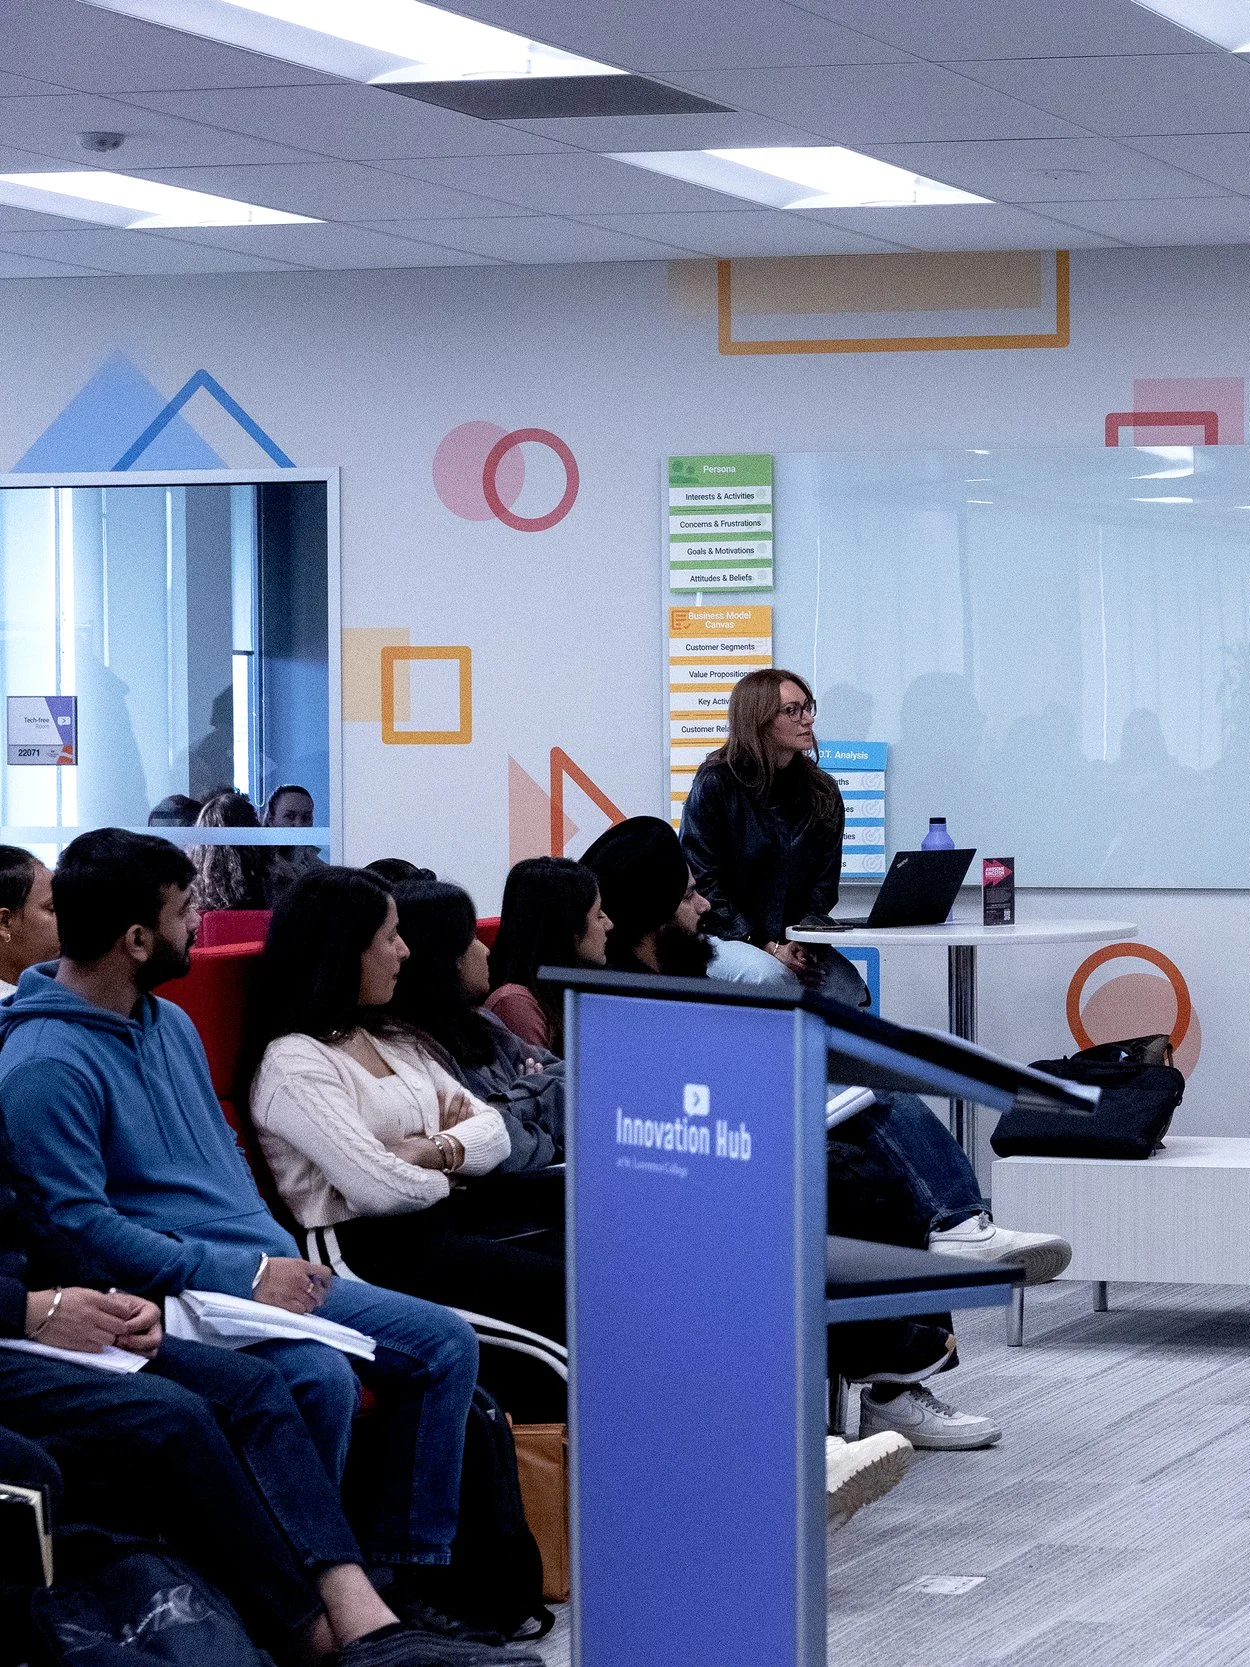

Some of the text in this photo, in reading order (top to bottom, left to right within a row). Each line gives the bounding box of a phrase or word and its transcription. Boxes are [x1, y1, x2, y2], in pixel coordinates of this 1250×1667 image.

[703, 465, 736, 473] Persona
[724, 492, 755, 500] Activities
[714, 520, 719, 528] &
[720, 519, 761, 527] Frustrations
[708, 547, 713, 555] &
[729, 573, 752, 582] Beliefs
[688, 611, 752, 620] Business Model
[705, 620, 735, 629] Canvas
[685, 643, 755, 652] Customer Segments
[698, 698, 711, 706] Key
[681, 725, 715, 733] Customer
[18, 748, 40, 757] 22071
[834, 750, 869, 760] Analysis
[616, 1106, 752, 1162] Innovation Hub
